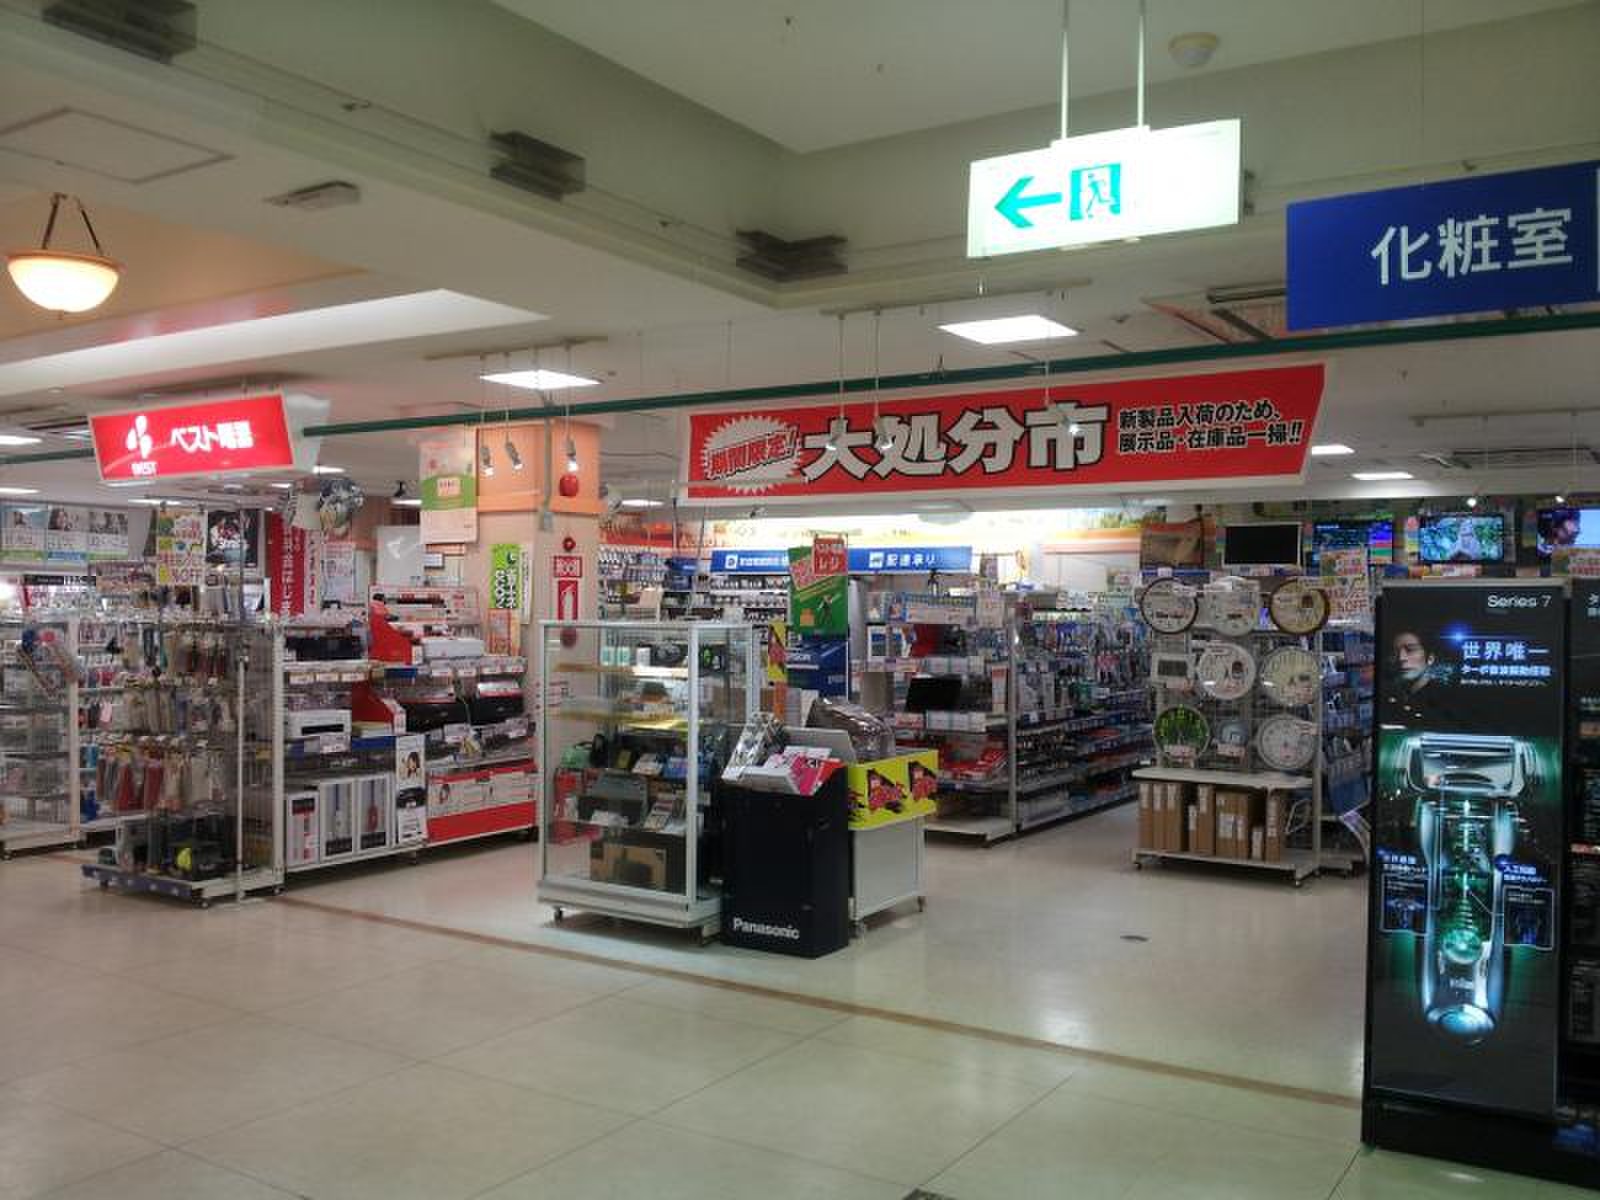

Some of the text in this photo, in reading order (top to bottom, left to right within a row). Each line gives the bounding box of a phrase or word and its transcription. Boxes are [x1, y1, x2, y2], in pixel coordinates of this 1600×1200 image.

[1370, 207, 1573, 286] 化粧室
[1119, 400, 1281, 432] 新製品入荷のため、
[801, 401, 1109, 484] 大処分市
[1487, 595, 1551, 608] Series 7
[1461, 641, 1549, 661] 世界唯一
[733, 917, 800, 940] Panasonic
